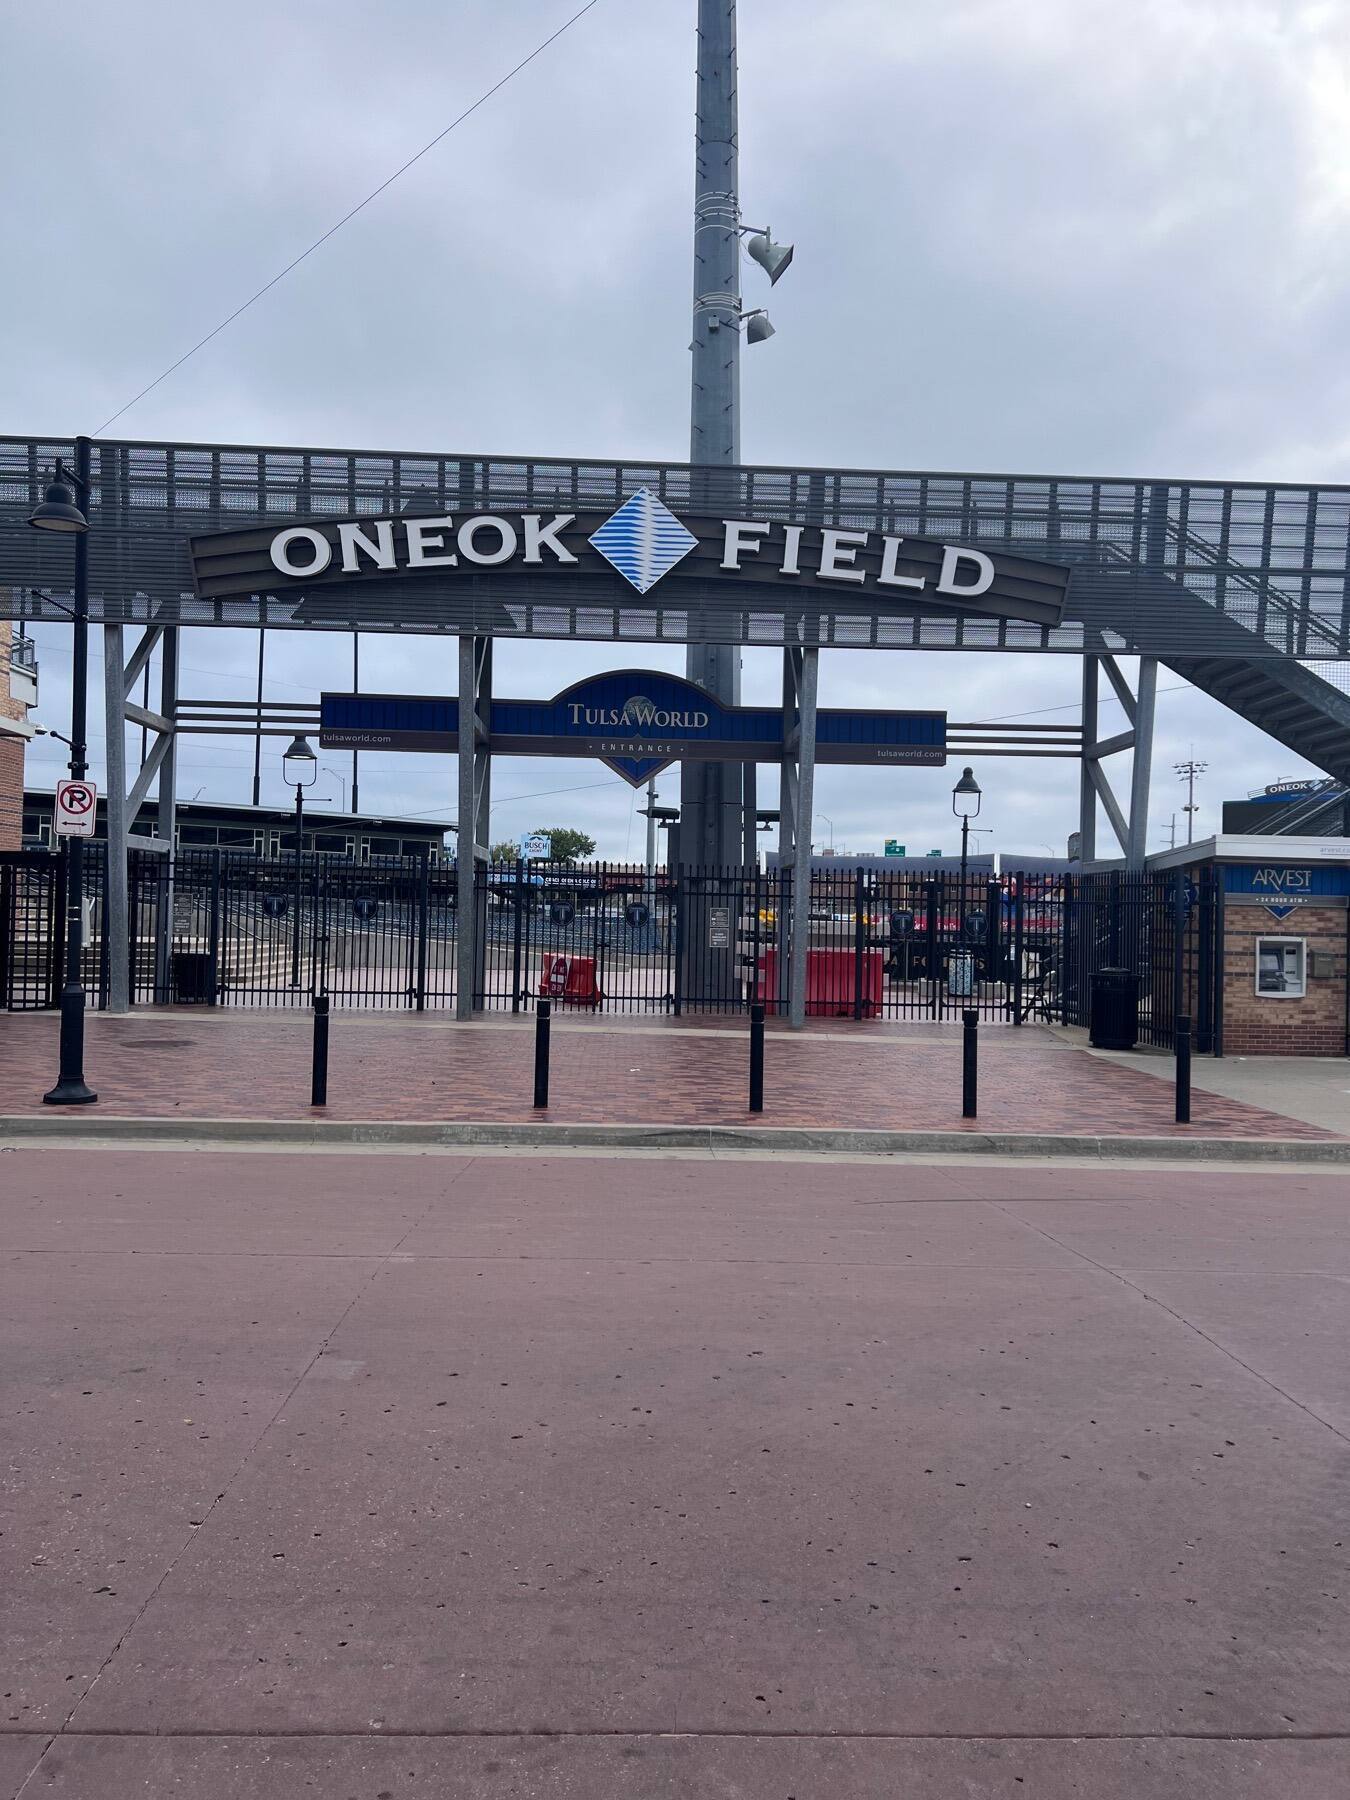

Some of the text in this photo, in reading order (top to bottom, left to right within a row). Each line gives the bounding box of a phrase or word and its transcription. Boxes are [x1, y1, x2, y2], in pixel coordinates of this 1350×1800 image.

[269, 512, 995, 598] ONEOK FIELD
[567, 703, 709, 728] TULSA WORLD
[322, 733, 392, 743] tulsaworld.com
[601, 743, 672, 753] ENTRANCE
[877, 750, 943, 758] tulsaworld.com
[1270, 783, 1307, 793] ONEOK
[524, 841, 548, 850] BUSCH
[1252, 869, 1312, 891] ARVEST
